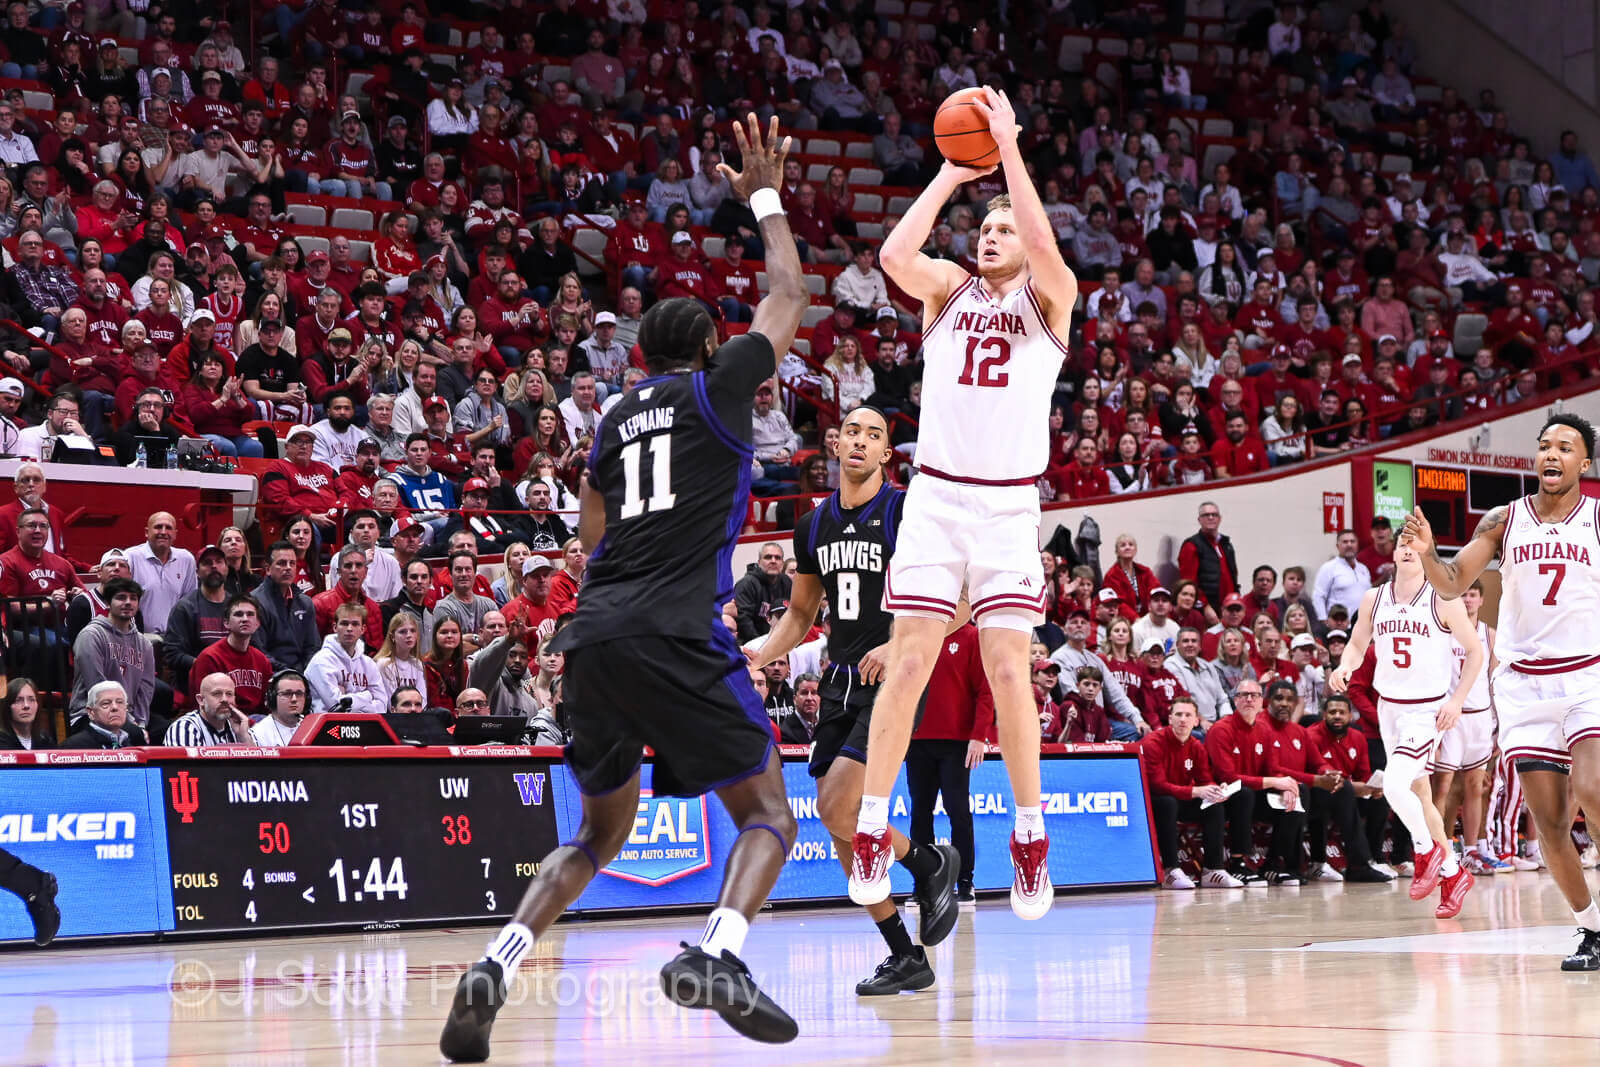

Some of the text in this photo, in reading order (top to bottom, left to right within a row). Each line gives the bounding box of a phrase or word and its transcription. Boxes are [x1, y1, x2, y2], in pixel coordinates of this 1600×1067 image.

[957, 335, 1011, 388] 12
[617, 406, 675, 443] KEPNANG
[1493, 454, 1536, 471] ASSEMBLY
[619, 433, 677, 520] 11
[1417, 468, 1466, 492] INDIANA
[412, 487, 445, 515] 15
[1329, 506, 1339, 529] 4
[816, 540, 882, 576] DAWGS
[1512, 541, 1592, 567] INDIANA
[837, 571, 860, 620] 8
[1538, 563, 1567, 606] 7
[1376, 619, 1431, 638] INDIANA
[1392, 637, 1412, 669] 5
[340, 726, 361, 739] POSS
[49, 752, 137, 764] German American Bank
[199, 748, 281, 759] German American Bank
[461, 747, 486, 757] German
[487, 747, 515, 757] American
[227, 780, 310, 803] INDIANA
[440, 777, 469, 799] UW
[340, 803, 379, 829] 1ST
[628, 801, 698, 844] EAL
[1105, 815, 1129, 827] TIRES
[258, 822, 291, 854] 50
[441, 814, 472, 846] 38
[95, 844, 135, 860] TIRES
[620, 847, 699, 861] AND AUTO SERVICE
[173, 868, 297, 891] FOULS 4 BONUS
[328, 856, 409, 903] 1:44
[480, 857, 541, 879] 7 FOU
[176, 900, 258, 923] TOL 4
[485, 890, 497, 911] 3
